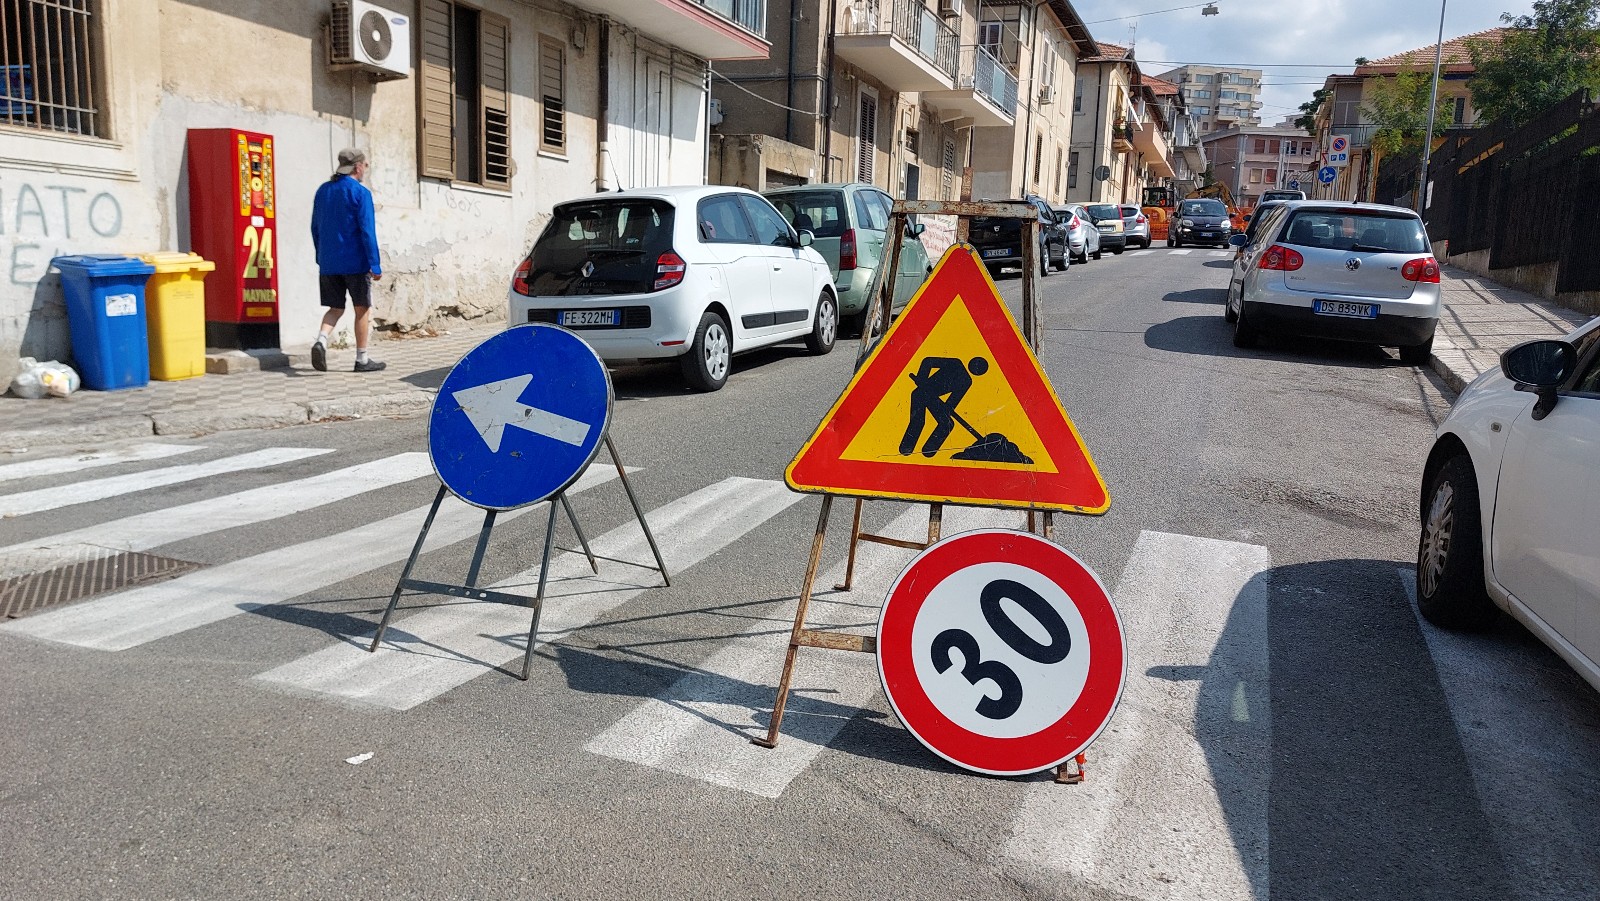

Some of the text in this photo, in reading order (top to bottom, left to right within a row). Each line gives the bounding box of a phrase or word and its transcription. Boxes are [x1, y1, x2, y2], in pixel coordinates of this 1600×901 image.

[242, 225, 273, 278] 24
[564, 311, 613, 324] FE 322MH
[1321, 302, 1371, 316] DS 839VK
[930, 579, 1072, 720] 30
